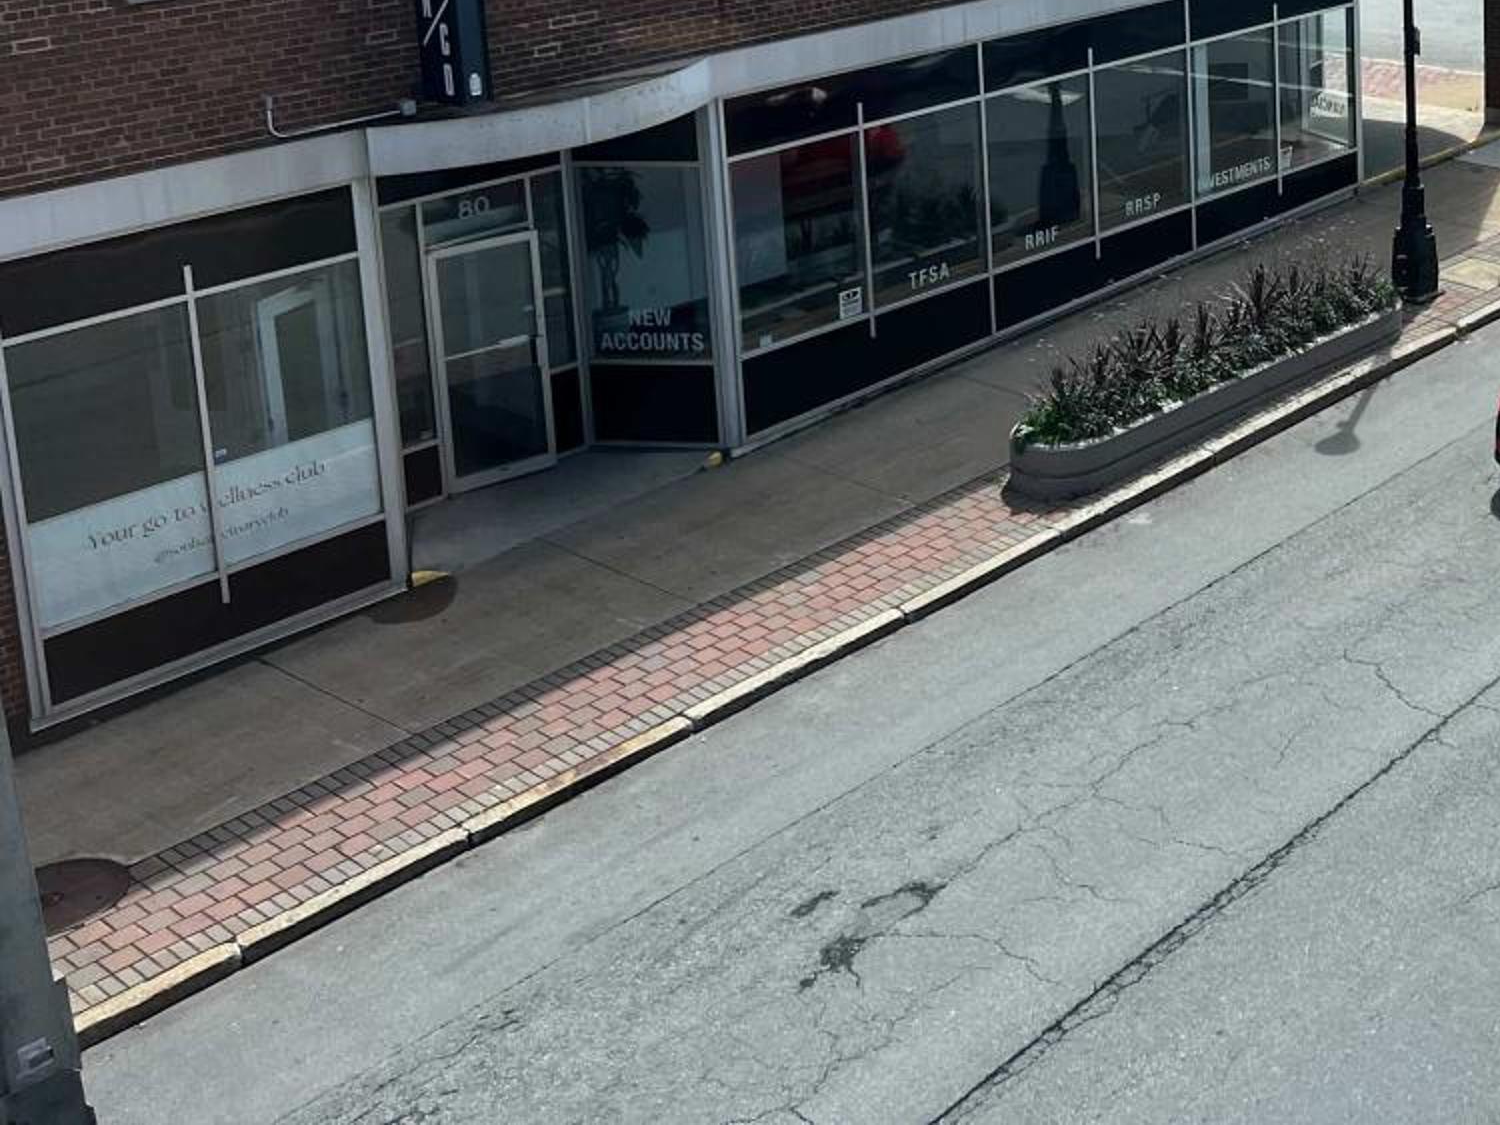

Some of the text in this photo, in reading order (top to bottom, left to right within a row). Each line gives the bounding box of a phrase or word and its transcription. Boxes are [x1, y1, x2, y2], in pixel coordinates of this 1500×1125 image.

[458, 196, 490, 220] 80
[1125, 192, 1161, 217] RRSP
[1025, 225, 1059, 250] RRIF
[908, 262, 950, 289] TFSA
[628, 306, 671, 327] NEW
[601, 331, 705, 352] ACCOUNTS
[87, 522, 136, 551] Your
[142, 514, 167, 538] go
[174, 504, 197, 523] to
[285, 461, 326, 486] club
